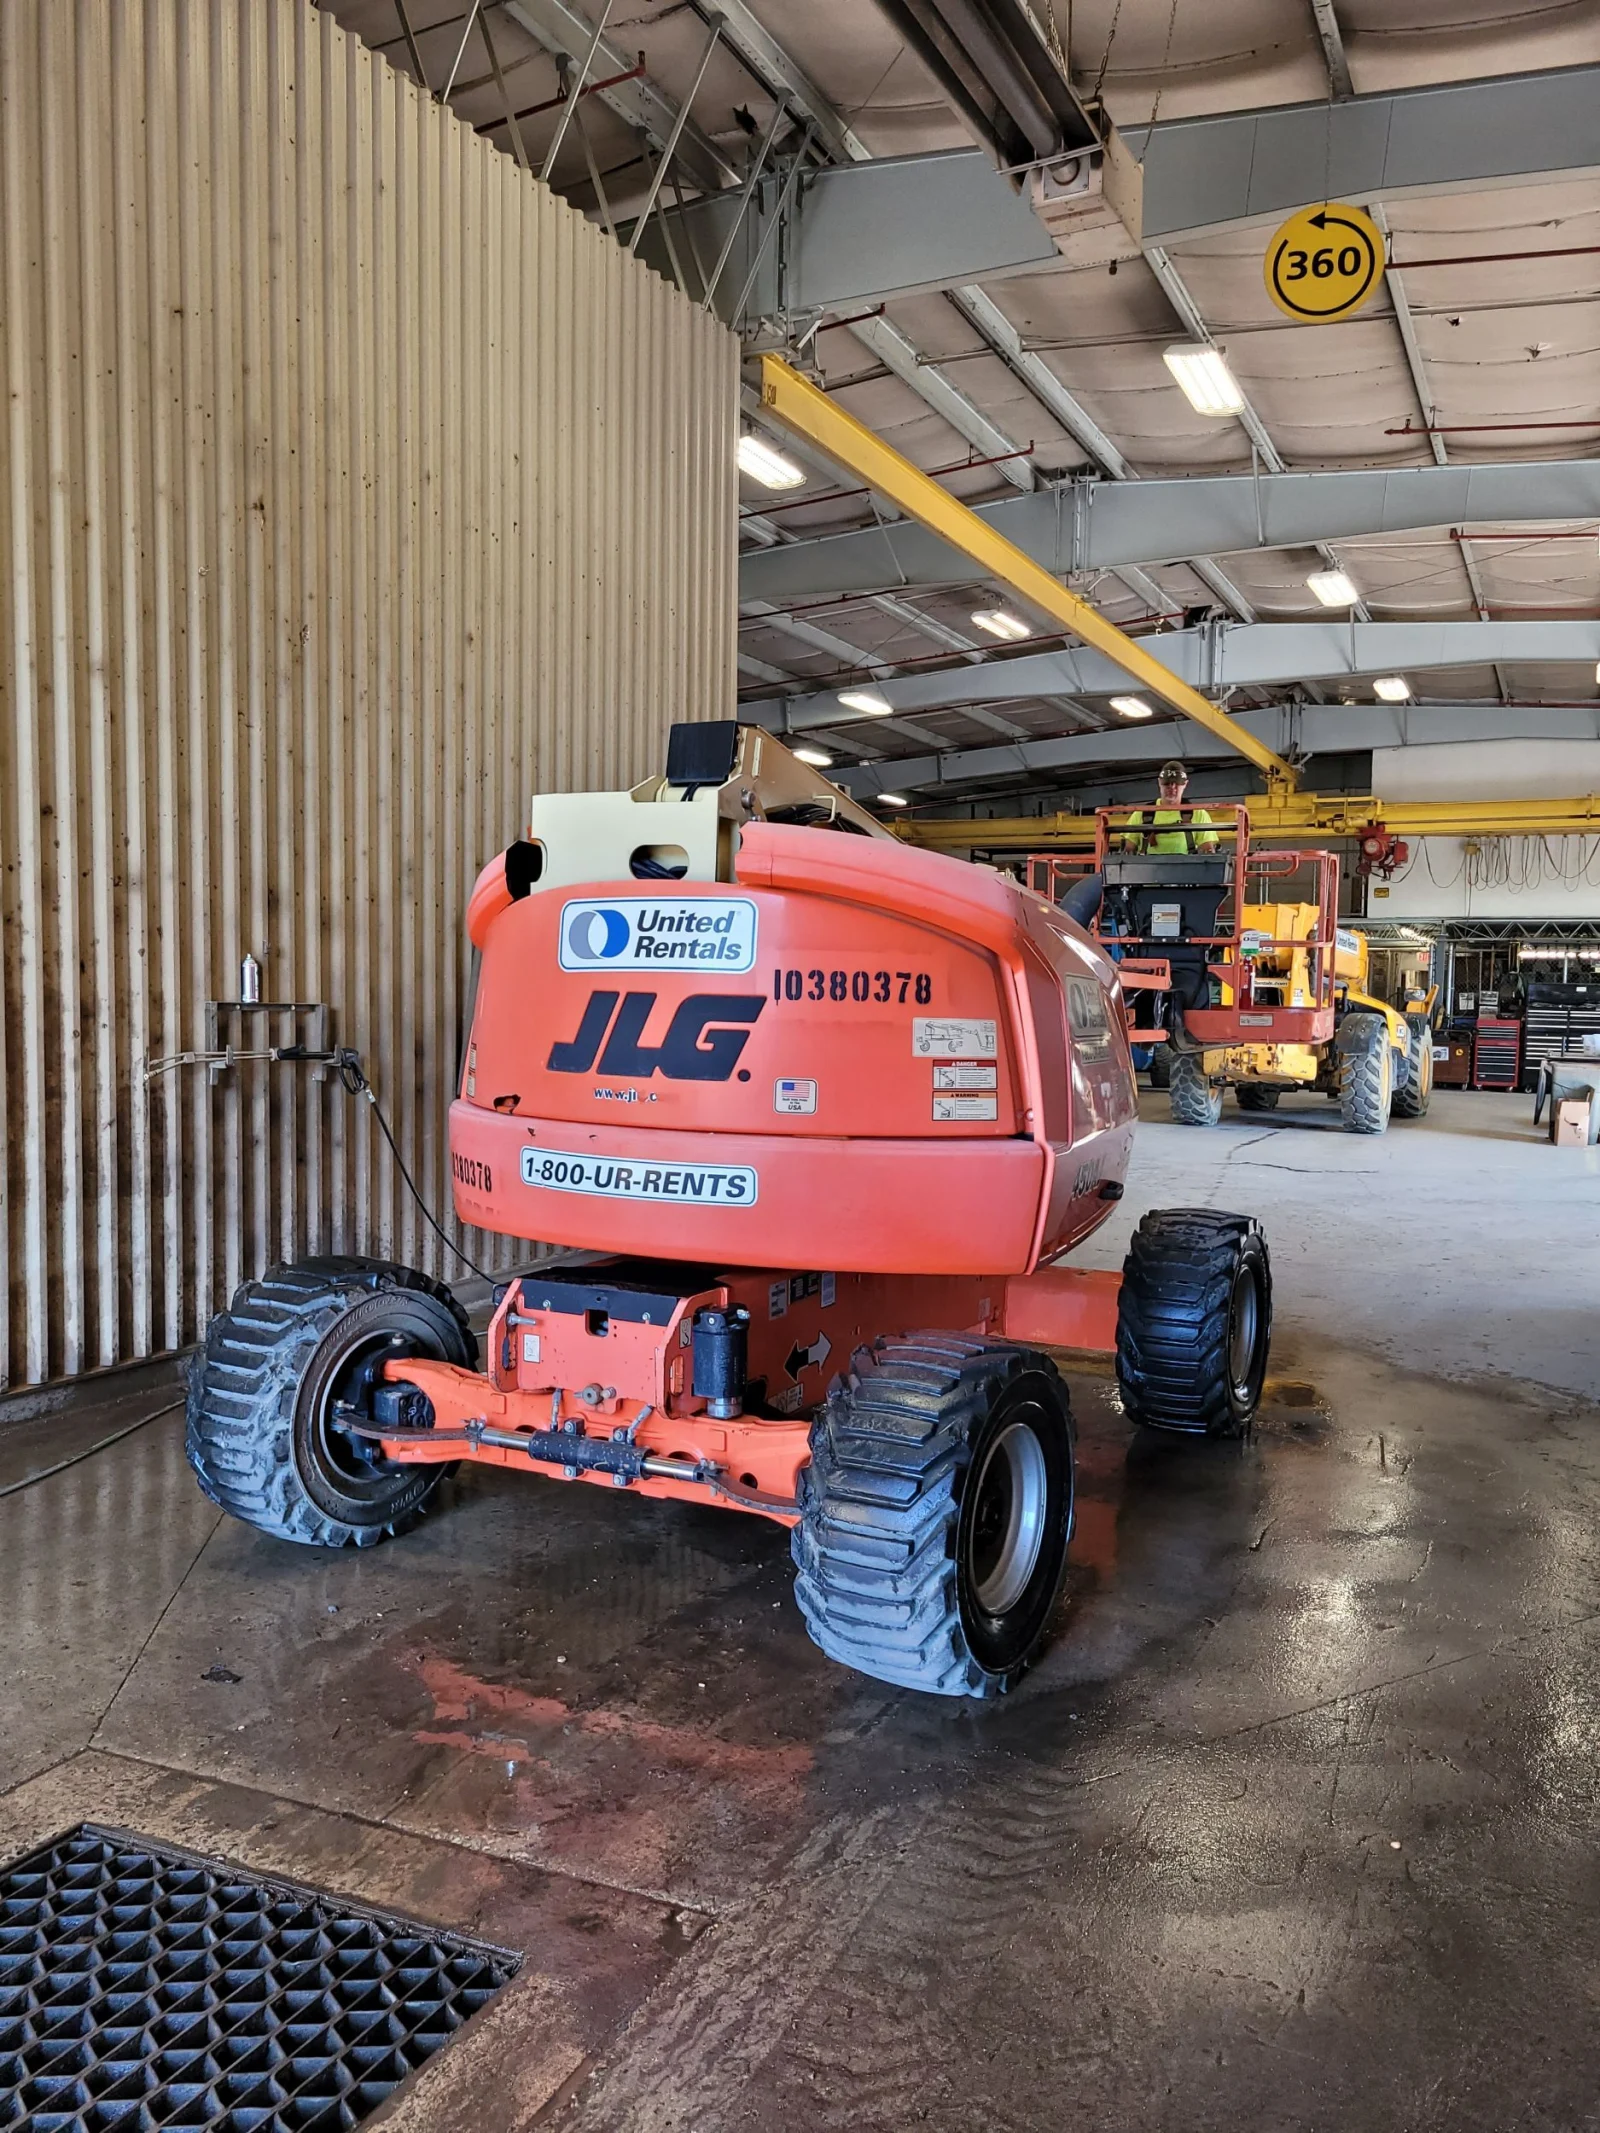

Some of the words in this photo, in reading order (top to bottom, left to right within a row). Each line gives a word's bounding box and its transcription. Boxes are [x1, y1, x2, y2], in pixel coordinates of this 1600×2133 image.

[1286, 246, 1362, 281] 360
[636, 909, 736, 934] United
[633, 935, 742, 961] Rentals
[774, 969, 932, 1005] 10380378
[525, 1156, 748, 1198] 1-800-UR-RENTS
